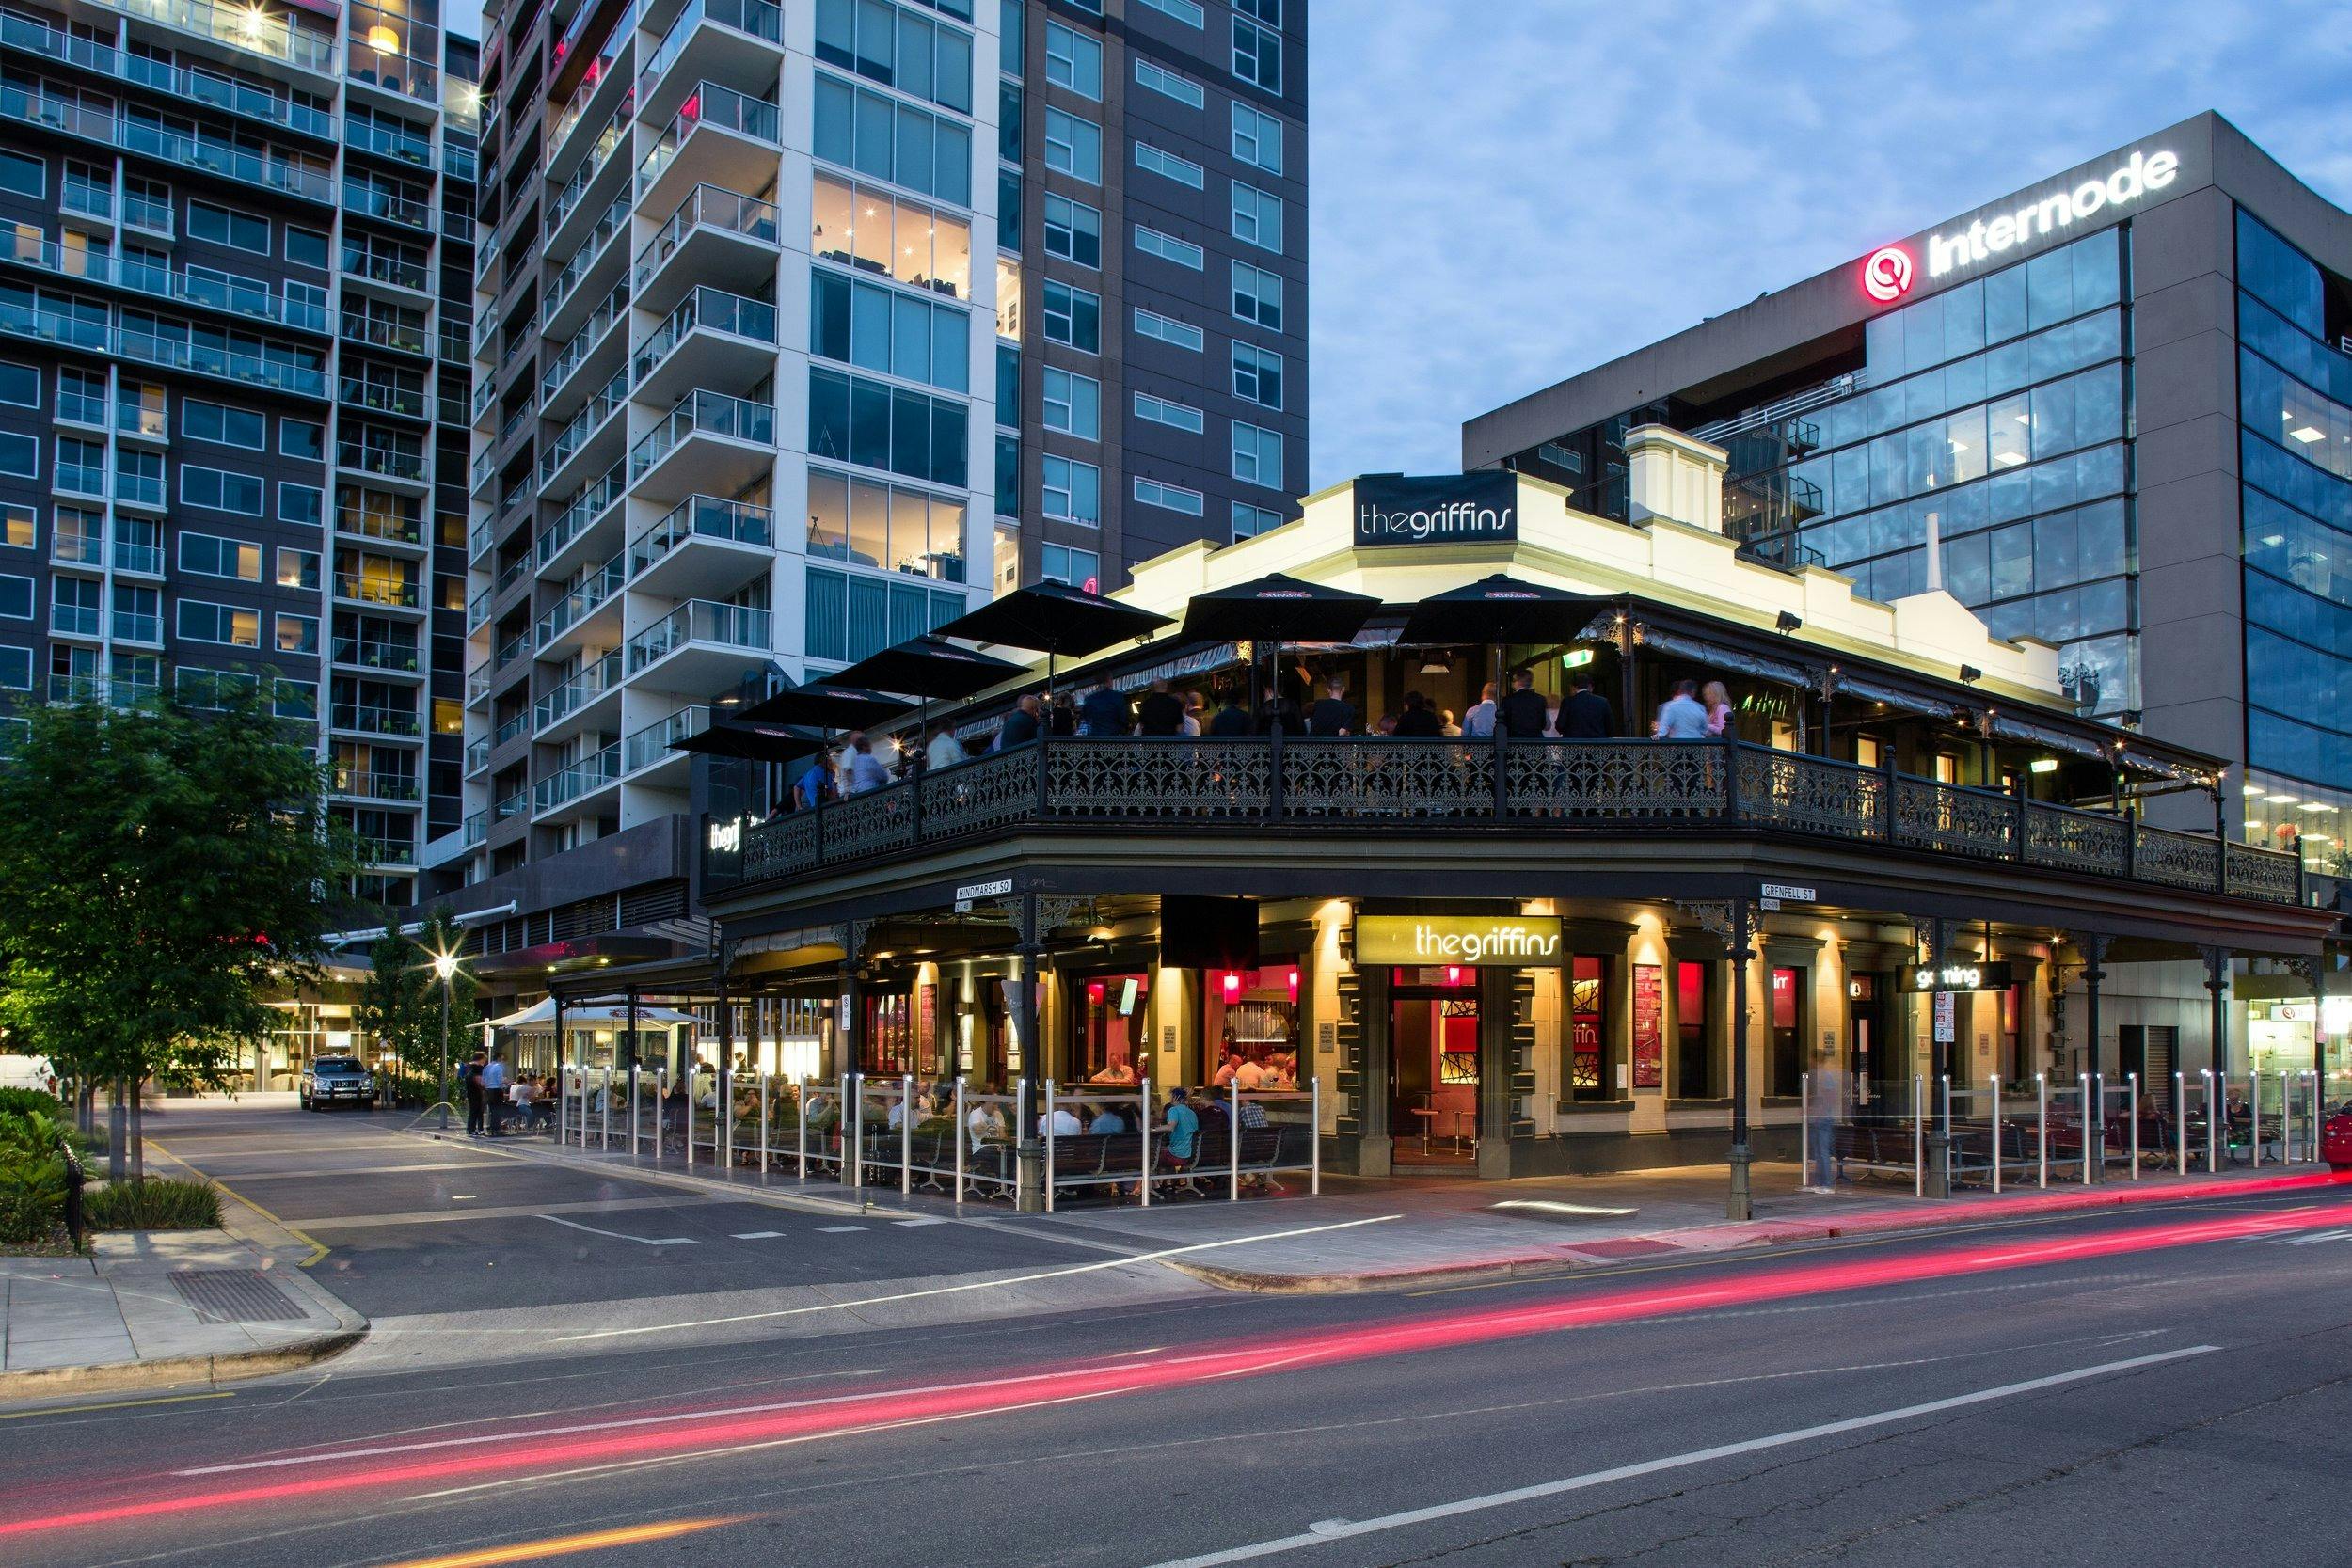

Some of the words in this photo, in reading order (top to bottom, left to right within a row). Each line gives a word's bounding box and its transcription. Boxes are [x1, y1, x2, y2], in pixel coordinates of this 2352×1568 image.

[1928, 150, 2180, 277] Internode
[1361, 502, 1512, 539] thegriffins
[959, 883, 997, 898] HINDMARSH
[999, 880, 1011, 893] SQ.
[1765, 885, 1801, 899] GRENFELL
[1803, 889, 1815, 900] ST.
[1416, 925, 1559, 961] thegriffins
